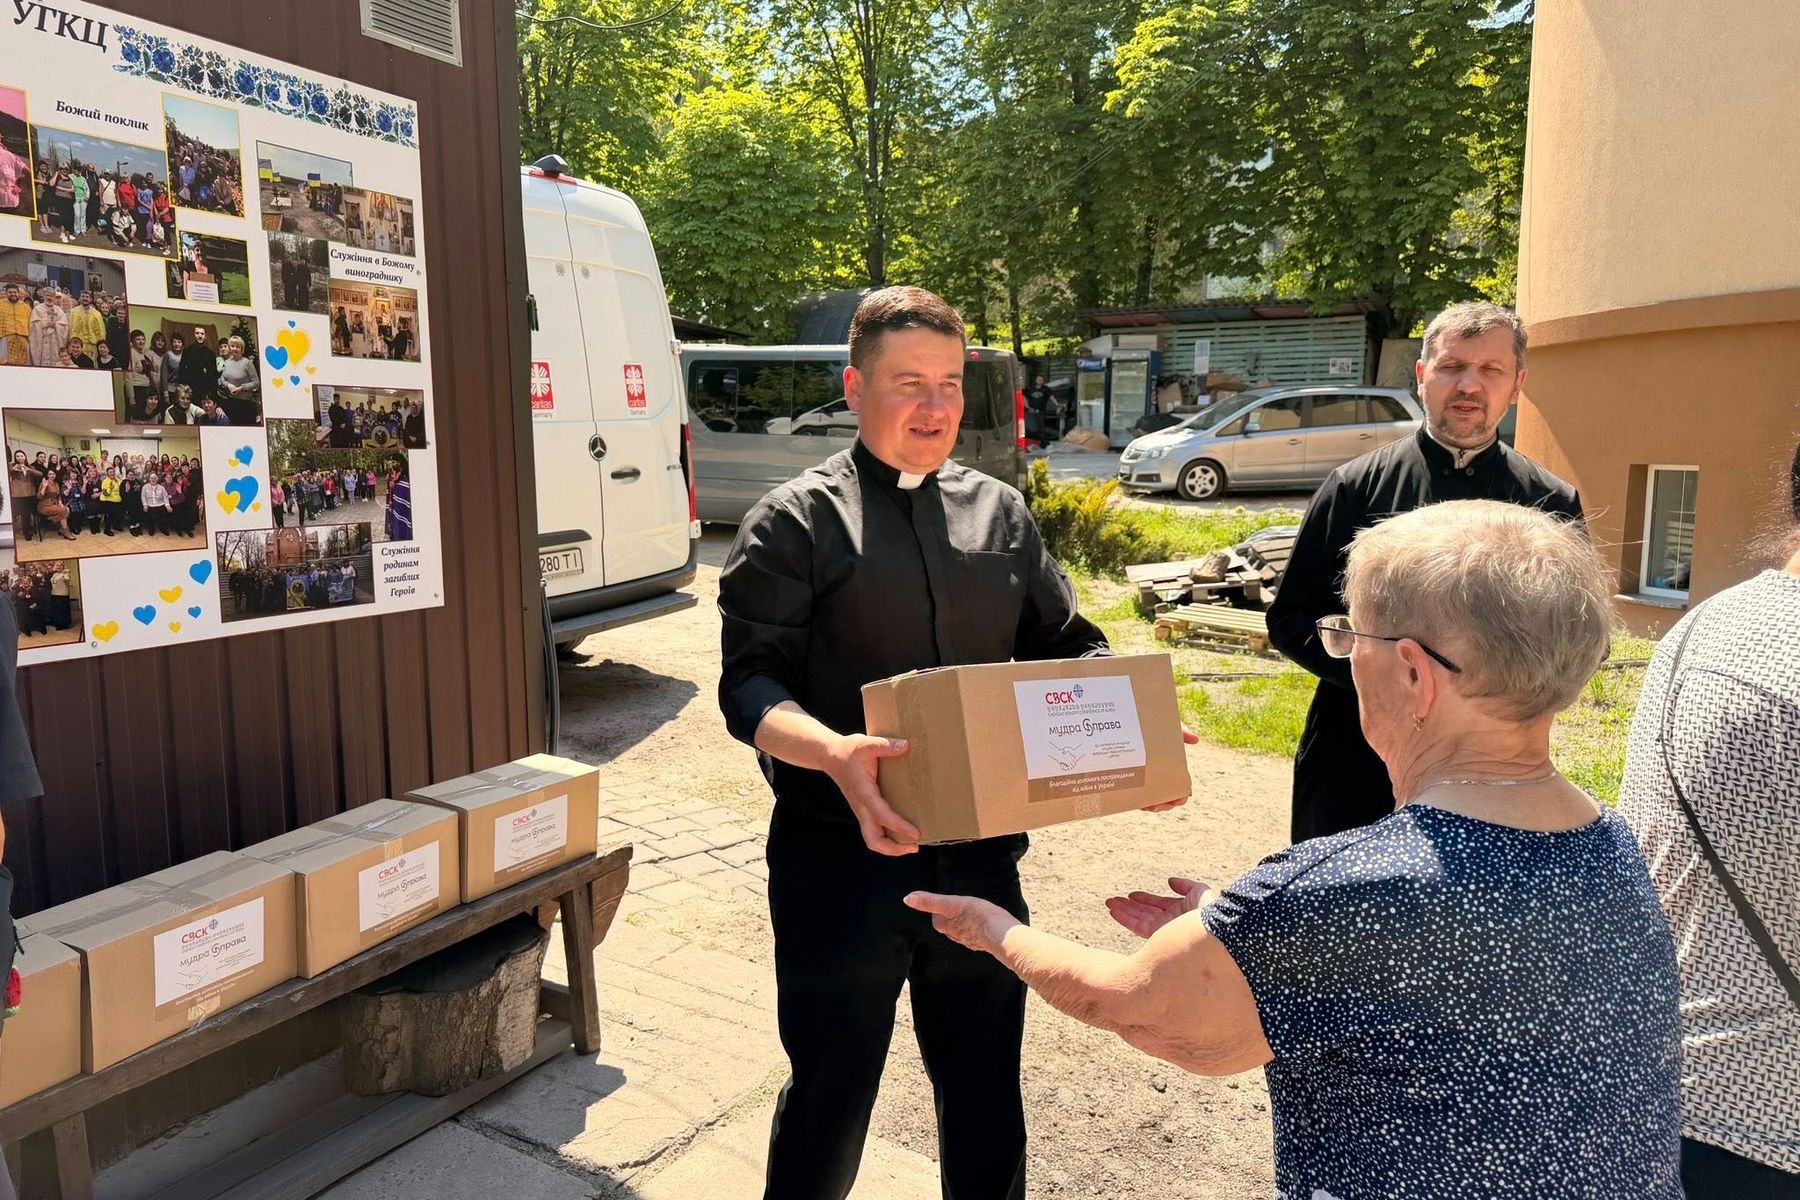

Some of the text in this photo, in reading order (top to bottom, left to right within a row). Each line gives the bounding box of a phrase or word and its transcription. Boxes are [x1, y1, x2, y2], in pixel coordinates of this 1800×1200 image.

[13, 0, 109, 53] УГКЦ
[56, 100, 149, 131] Божий поклик
[330, 248, 373, 265] Служіння
[382, 256, 415, 272] Божому
[344, 268, 404, 284] винограднику
[381, 545, 420, 557] Служіння
[383, 559, 419, 572] родинам
[383, 572, 420, 584] загиблих
[390, 585, 416, 598] Героїв
[1049, 724, 1081, 737] мудра
